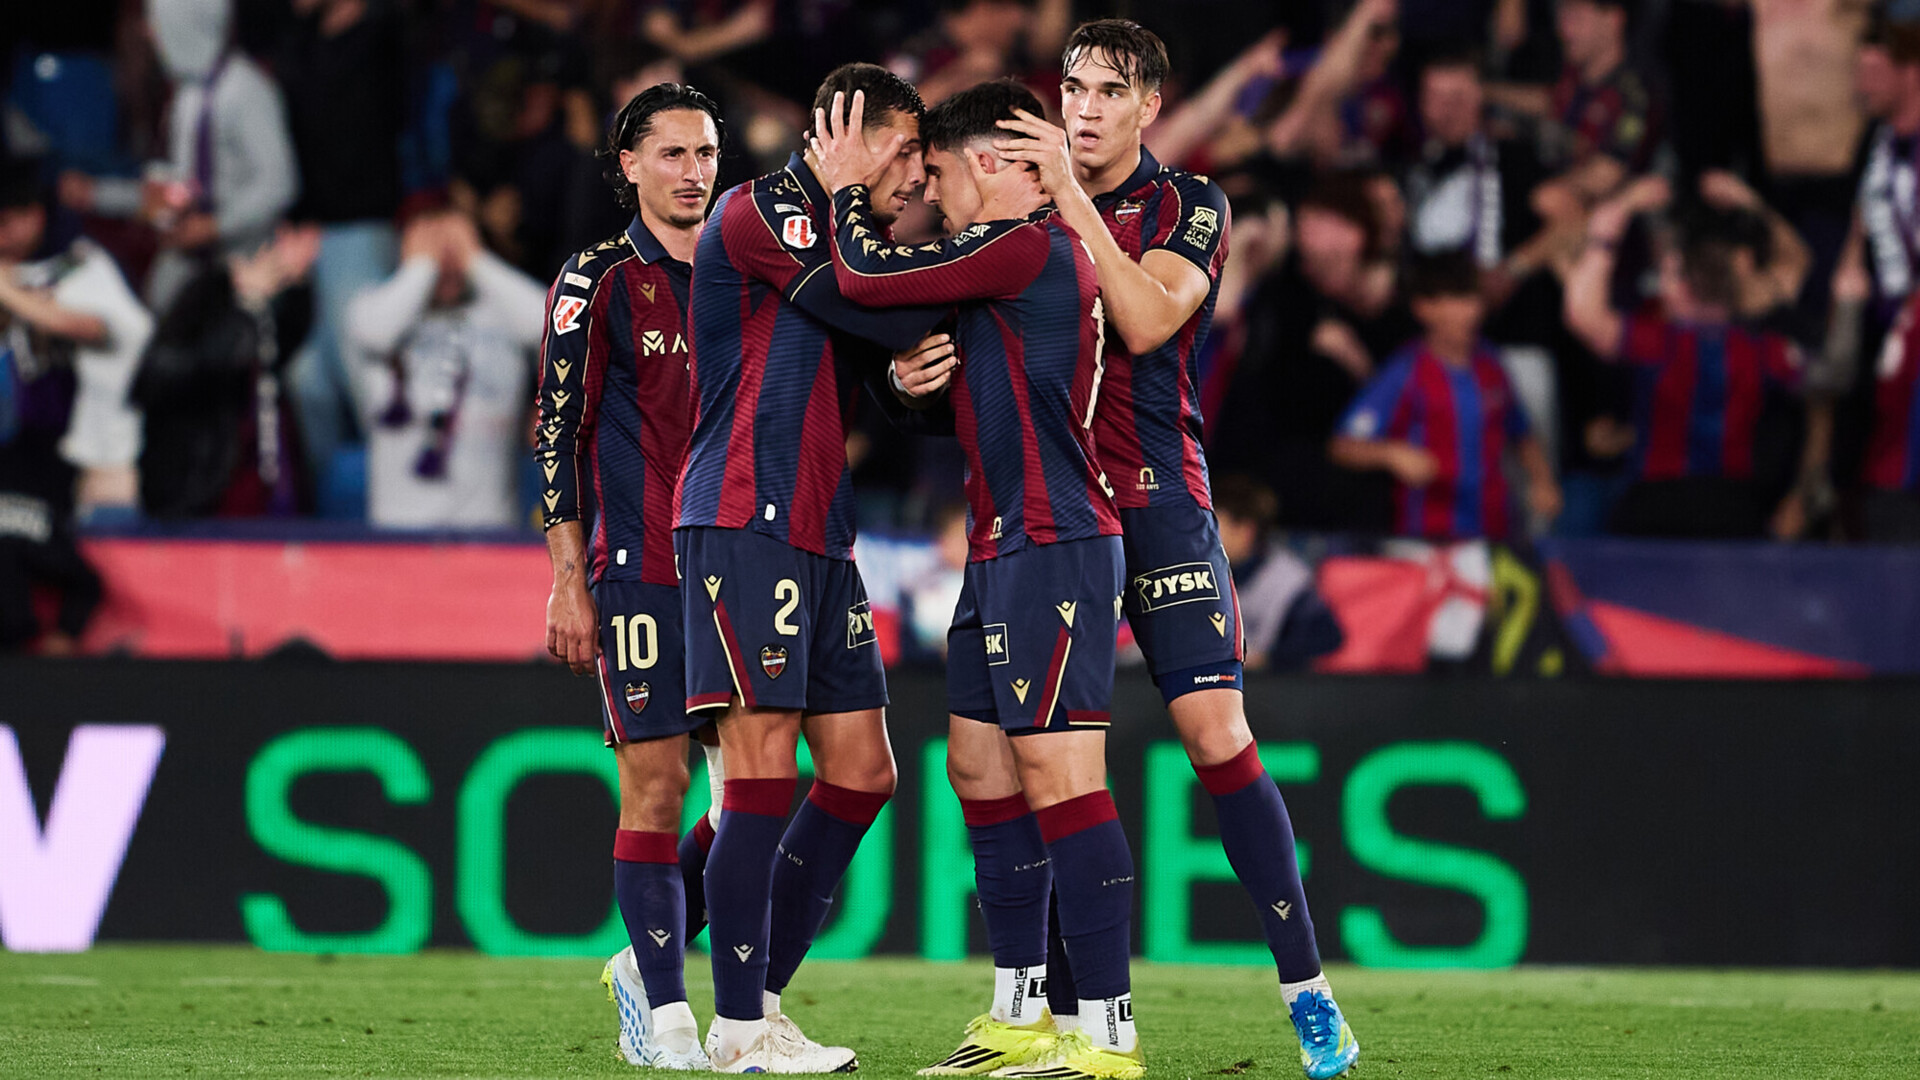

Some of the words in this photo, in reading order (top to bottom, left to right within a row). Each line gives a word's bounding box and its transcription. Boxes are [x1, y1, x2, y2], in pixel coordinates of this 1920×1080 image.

[1183, 234, 1207, 251] HOME
[774, 578, 800, 636] 2
[1152, 571, 1214, 598] JYSK
[610, 613, 659, 671] 10
[1105, 1001, 1119, 1047] TAPEDESIGN
